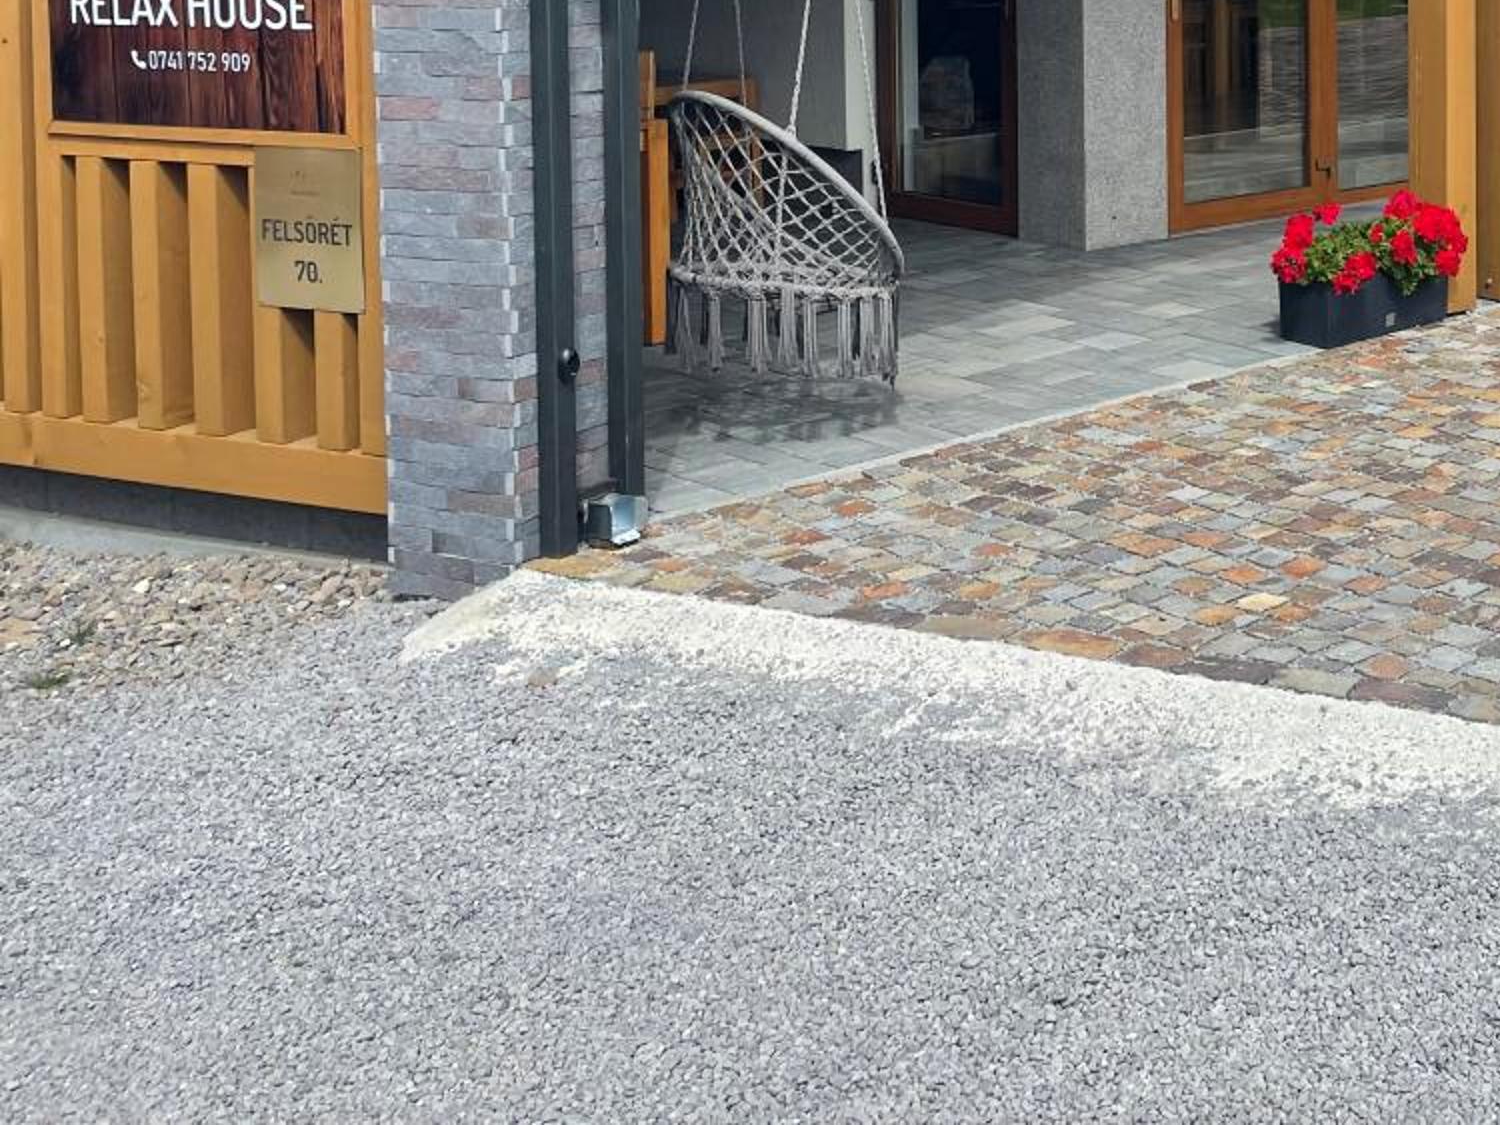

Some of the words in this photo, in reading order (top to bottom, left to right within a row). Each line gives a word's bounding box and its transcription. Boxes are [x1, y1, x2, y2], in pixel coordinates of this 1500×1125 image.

[149, 50, 183, 71] 0741
[187, 51, 218, 72] 752
[221, 52, 251, 73] 909
[294, 260, 323, 284] 70.
